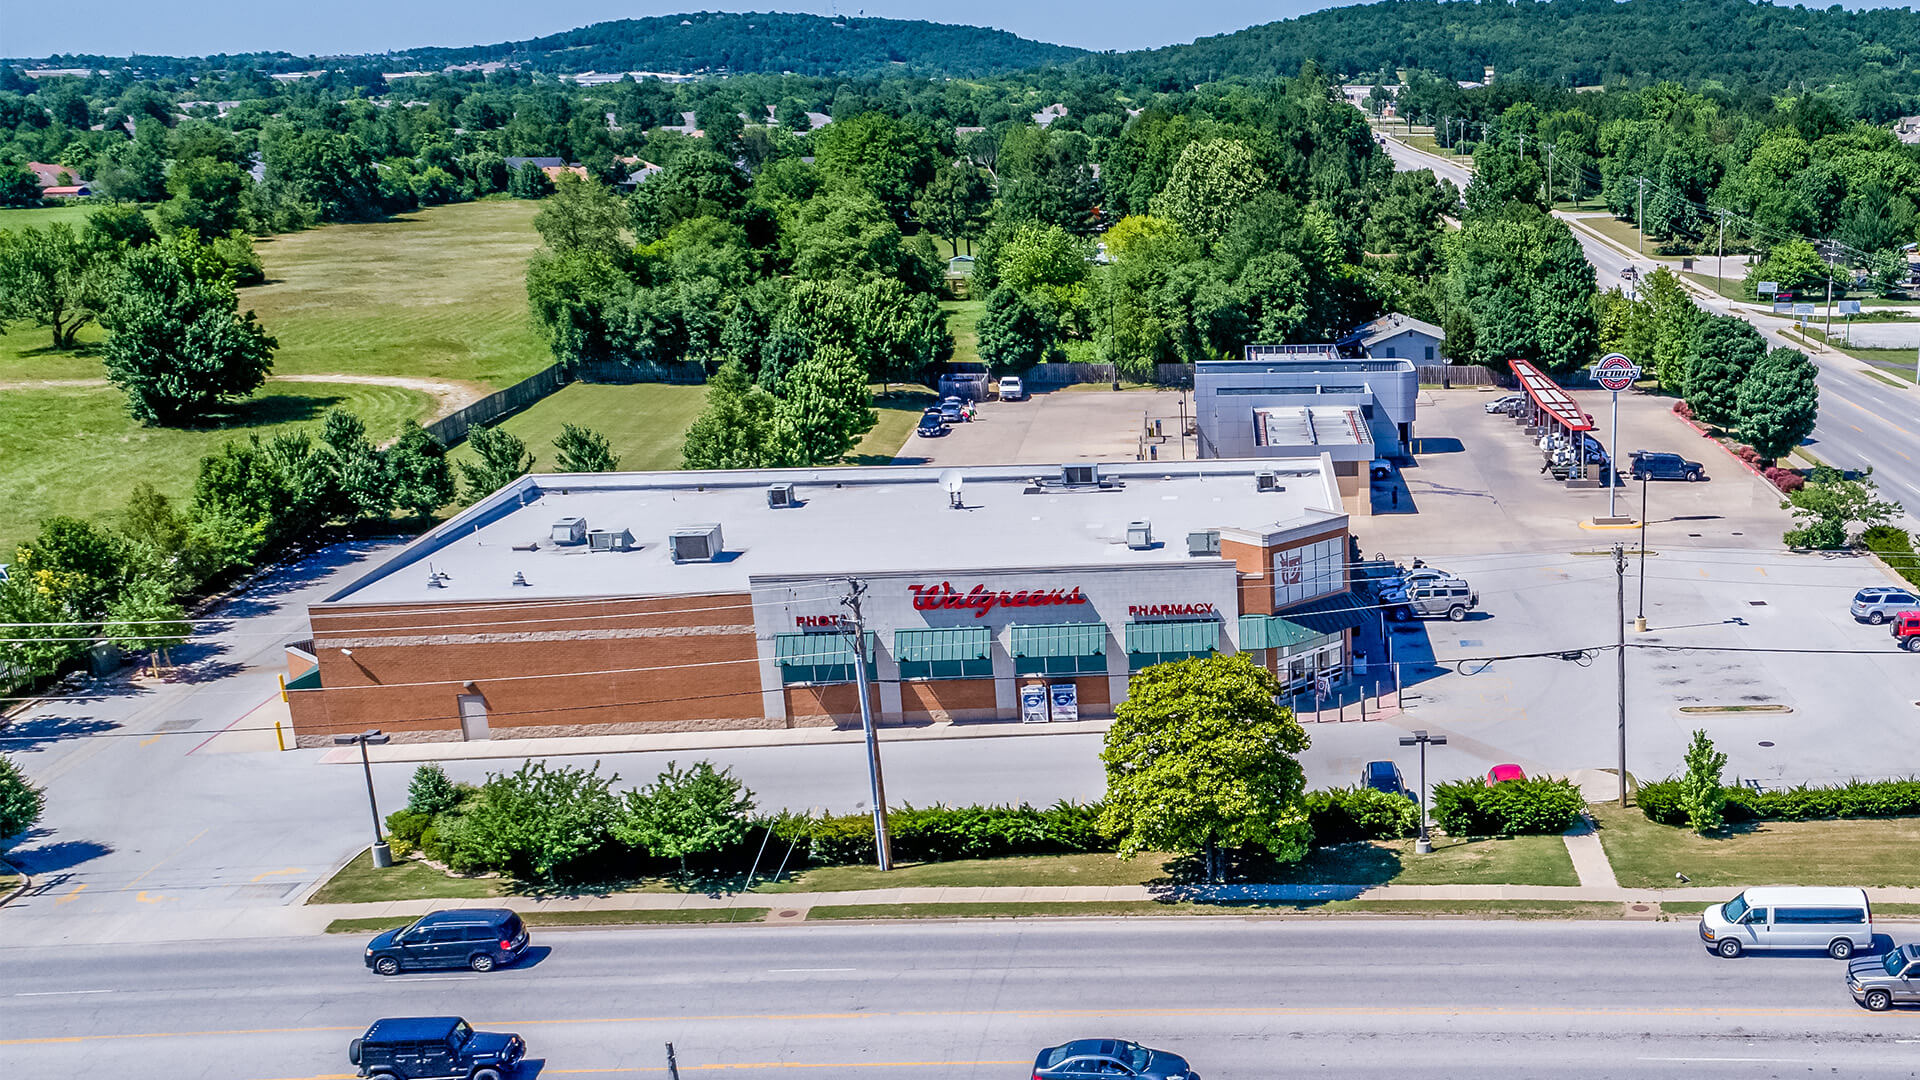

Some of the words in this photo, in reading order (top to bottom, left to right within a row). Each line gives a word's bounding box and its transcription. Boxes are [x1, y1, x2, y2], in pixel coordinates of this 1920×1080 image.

[1595, 369, 1637, 377] DETAILS
[908, 581, 1086, 618] Walgreens
[1128, 603, 1213, 616] PHARMACY
